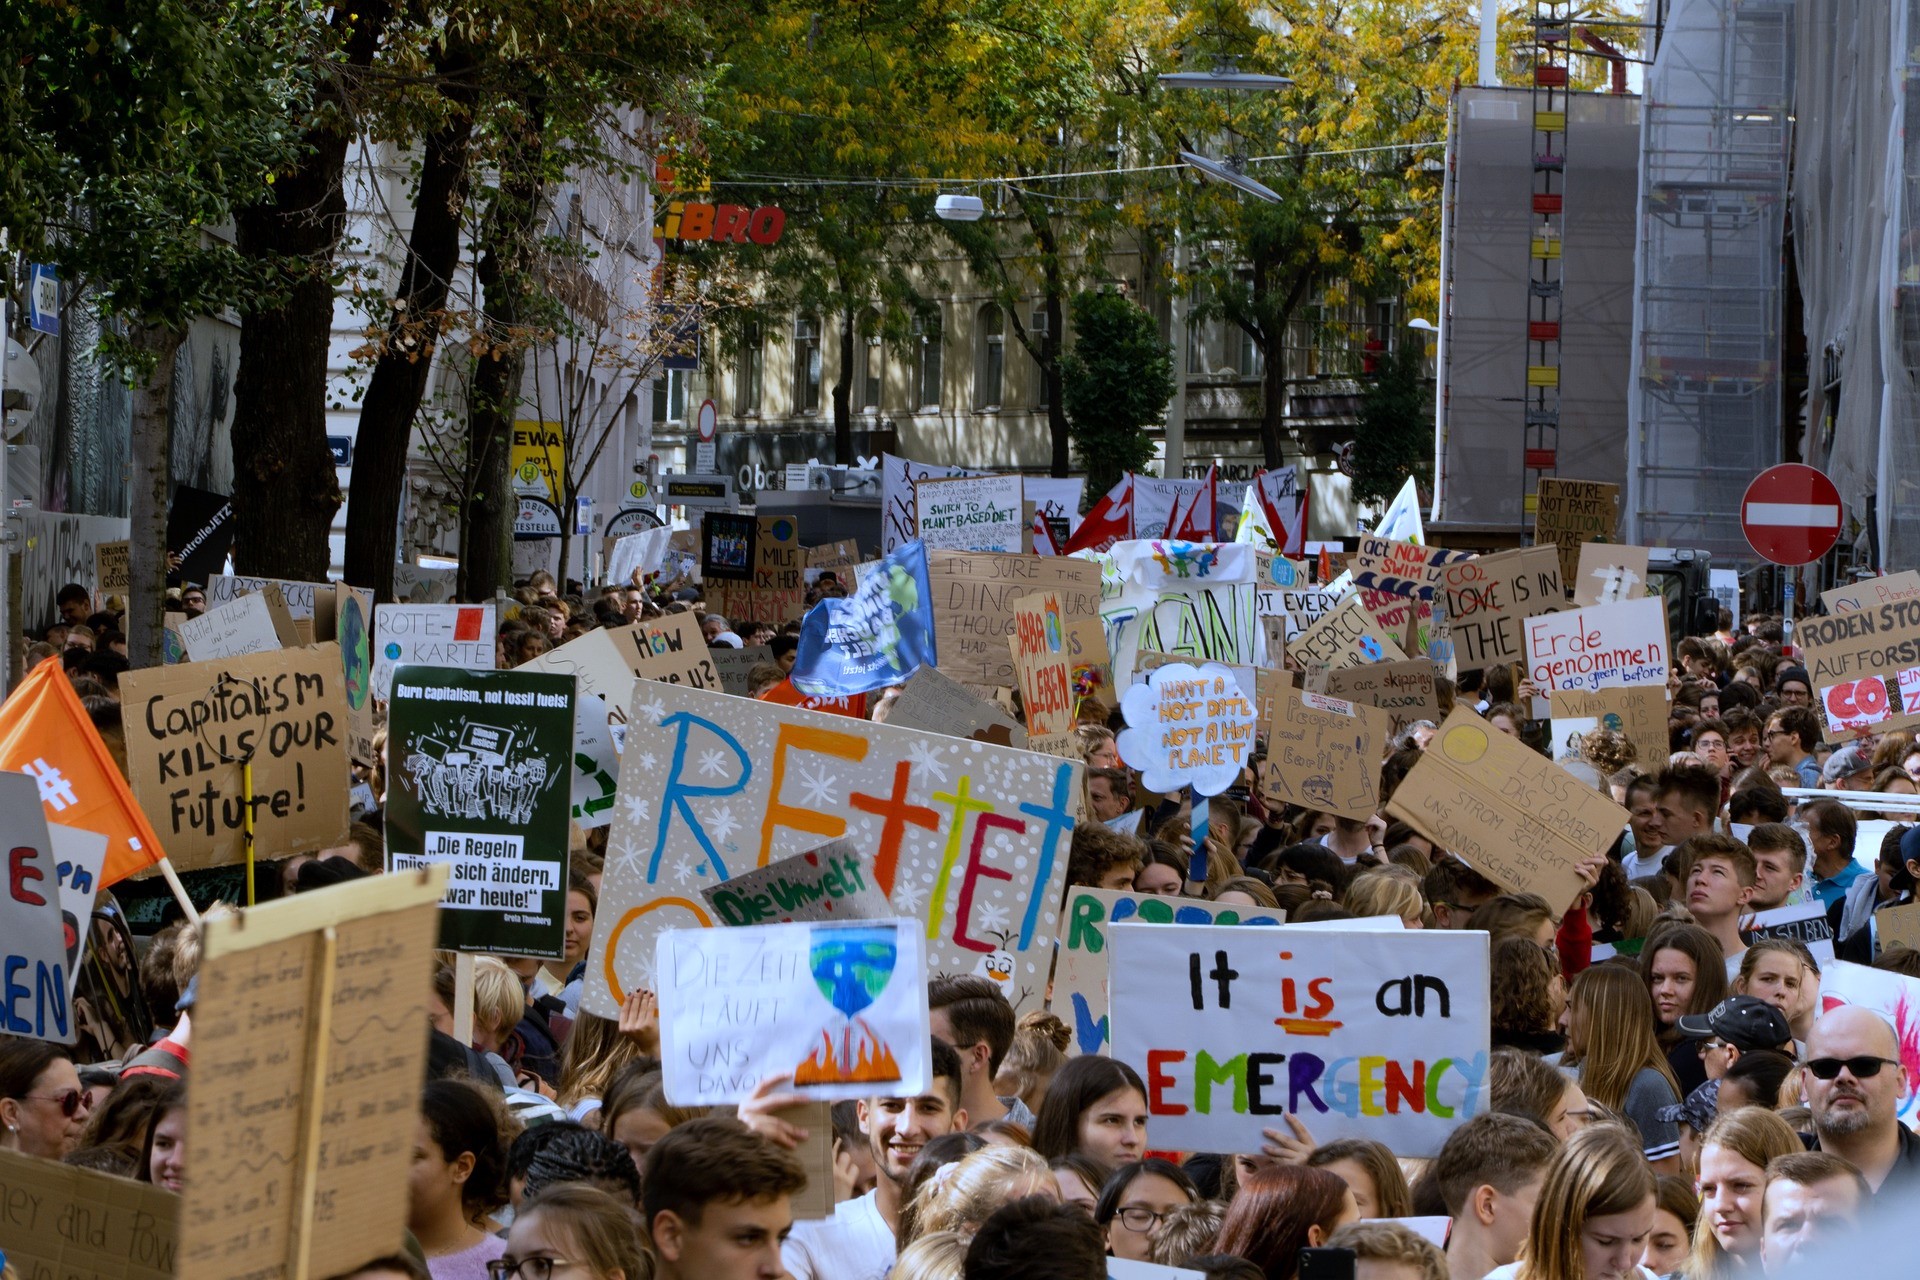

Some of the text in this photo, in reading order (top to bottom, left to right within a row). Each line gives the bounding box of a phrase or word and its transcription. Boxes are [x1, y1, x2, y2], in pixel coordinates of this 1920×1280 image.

[1541, 480, 1605, 499] IF YOU'RE
[930, 501, 996, 515] SWITCH TO A
[1539, 498, 1599, 515] NOT PART
[515, 522, 556, 532] TESTELLE
[922, 508, 1016, 530] PLANT-BASED DIET
[1538, 529, 1583, 546] YOU'RE
[1364, 539, 1428, 563] act NOW
[778, 569, 799, 589] HER
[989, 557, 1040, 579] SURE
[1056, 569, 1081, 581] THE
[1359, 556, 1422, 580] or SWIM
[1511, 575, 1530, 603] IS
[1538, 570, 1558, 597] IN
[1285, 592, 1341, 612] EVERY
[952, 614, 1016, 636] THOUG
[1376, 607, 1405, 630] NOT
[1802, 600, 1920, 648] RODEN STO
[960, 639, 987, 655] HAD
[1452, 616, 1518, 661] THE
[1532, 614, 1602, 659] Erde
[413, 642, 491, 664] KARTE
[976, 662, 1012, 678] TO
[1534, 643, 1661, 690] genommen
[1588, 667, 1618, 690] green
[1622, 666, 1664, 682] before
[1214, 676, 1225, 693] A
[1354, 678, 1379, 691] are
[1383, 671, 1434, 694] skipping
[397, 683, 568, 708] Burn capitalism, not fossil fuels!
[1373, 694, 1426, 709] lessons
[1558, 694, 1645, 716] WHEN OUR
[1158, 697, 1253, 723] HOT DATE
[1632, 709, 1648, 726] IS
[270, 711, 338, 763] OUR
[1162, 726, 1203, 748] NOT
[1206, 725, 1218, 743] A
[1168, 742, 1246, 770] PLANET
[1284, 746, 1345, 773] Earth:
[1452, 790, 1504, 831] STROM
[1499, 776, 1608, 852] DAS GRABEN
[1423, 794, 1571, 872] UNS SCHICKT
[465, 837, 517, 859] Regeln
[1432, 819, 1539, 892] SONNENSCHEIN! DER
[455, 862, 487, 882] sich
[492, 862, 554, 888] ändern,
[765, 854, 867, 913] Umwelt
[504, 912, 552, 927] Greta Thunberg
[1775, 918, 1831, 942] SELBEN
[1189, 949, 1451, 1020] It is an
[688, 1039, 750, 1068] UNS
[699, 1073, 763, 1096] DAVO
[1146, 1048, 1488, 1120] EMERGENCY
[57, 1201, 107, 1247] and
